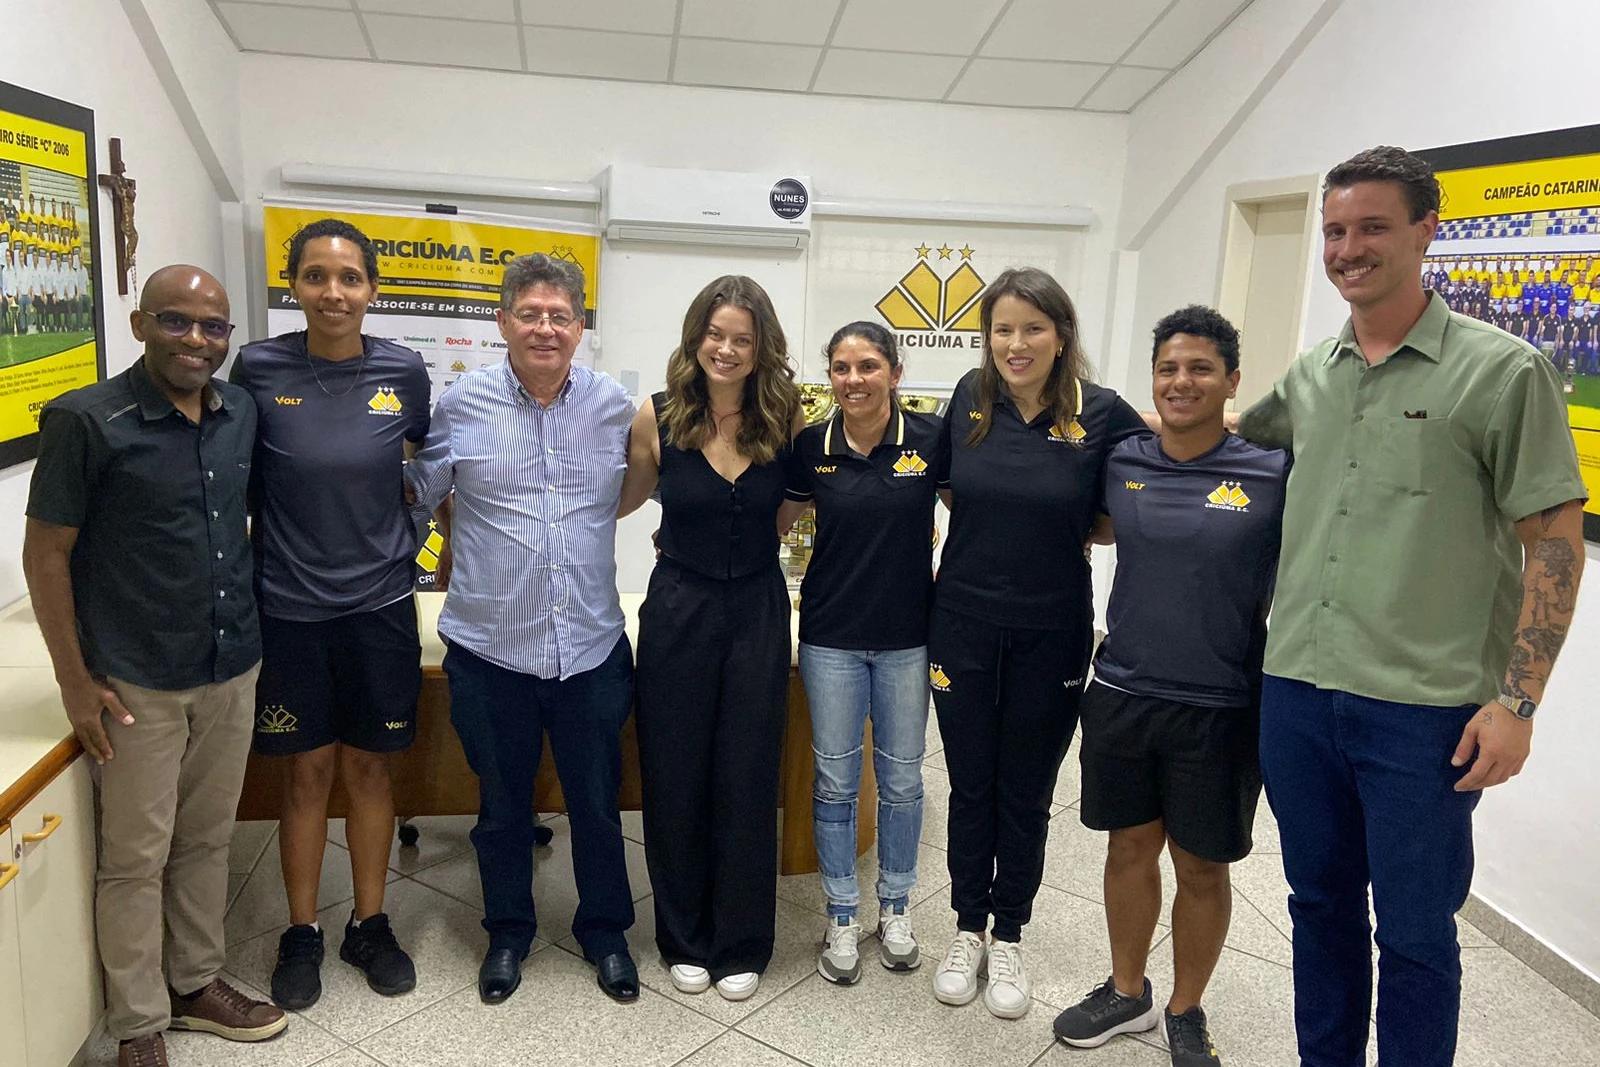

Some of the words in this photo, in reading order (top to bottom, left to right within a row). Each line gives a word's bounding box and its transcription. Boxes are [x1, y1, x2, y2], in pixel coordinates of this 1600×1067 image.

[16, 131, 39, 150] SÉRIE
[53, 141, 70, 157] 2006
[1484, 182, 1541, 201] CAMPEÃO
[1544, 178, 1600, 196] CATARIN
[773, 193, 806, 204] NUNES
[372, 237, 476, 264] RICIÚMA
[367, 300, 435, 311] ASSOCIE-SE
[438, 303, 455, 312] EM
[445, 336, 473, 346] Rocha
[893, 332, 964, 349] ICIÚMA
[274, 395, 303, 406] VOLT
[968, 410, 983, 420] VO
[814, 465, 837, 474] VOLT
[1125, 480, 1147, 491] VOLT
[1063, 676, 1084, 689] VOLT
[385, 720, 408, 731] VOLT
